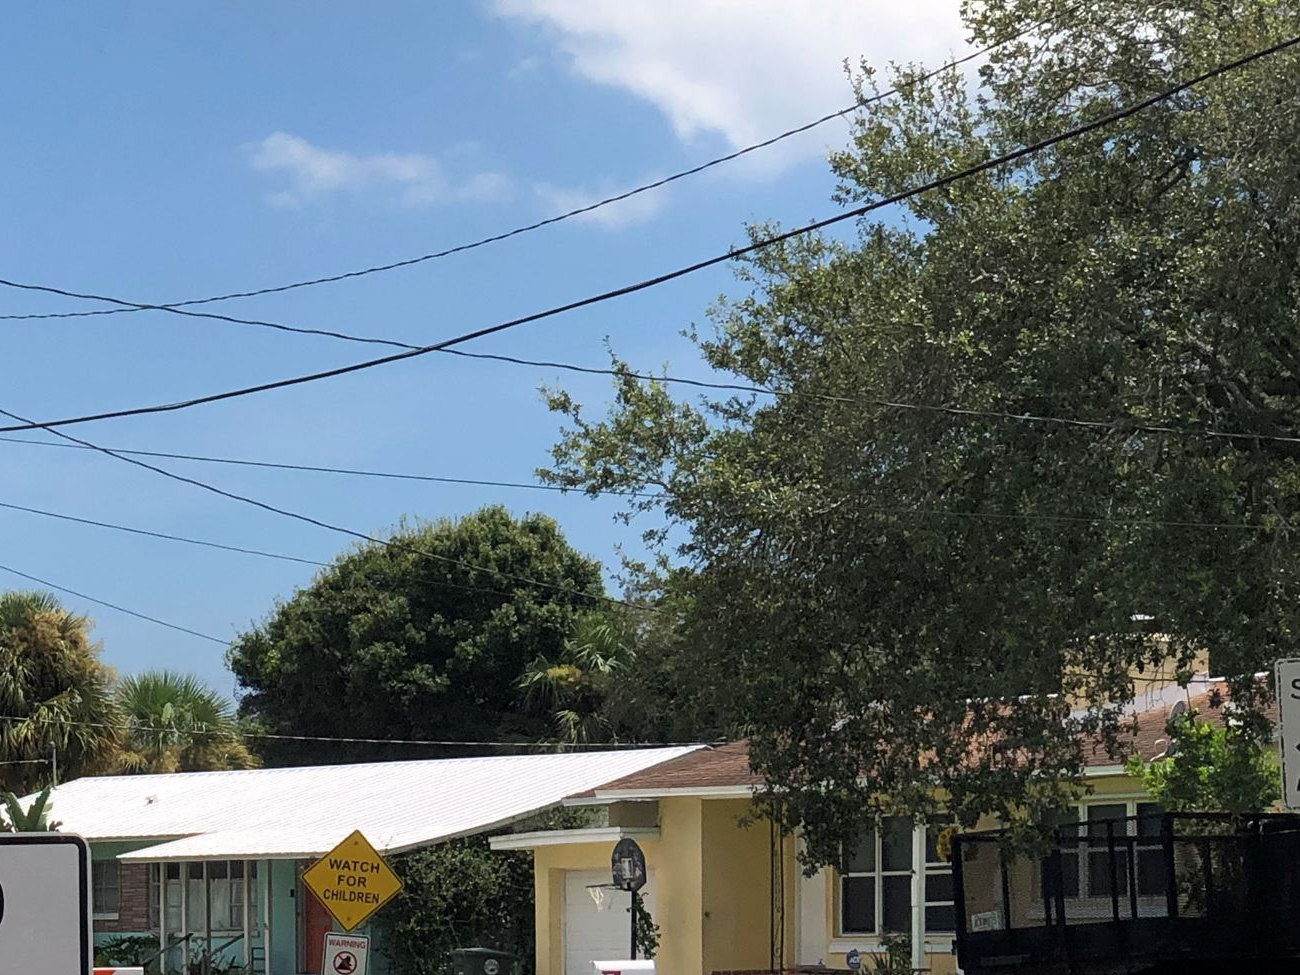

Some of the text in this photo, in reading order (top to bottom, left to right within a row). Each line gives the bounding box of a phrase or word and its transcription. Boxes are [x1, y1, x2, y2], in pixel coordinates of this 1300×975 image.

[328, 857, 381, 874] WATCH
[336, 874, 368, 888] FOR
[322, 888, 380, 905] CHILDREN
[328, 938, 366, 949] WARNING
